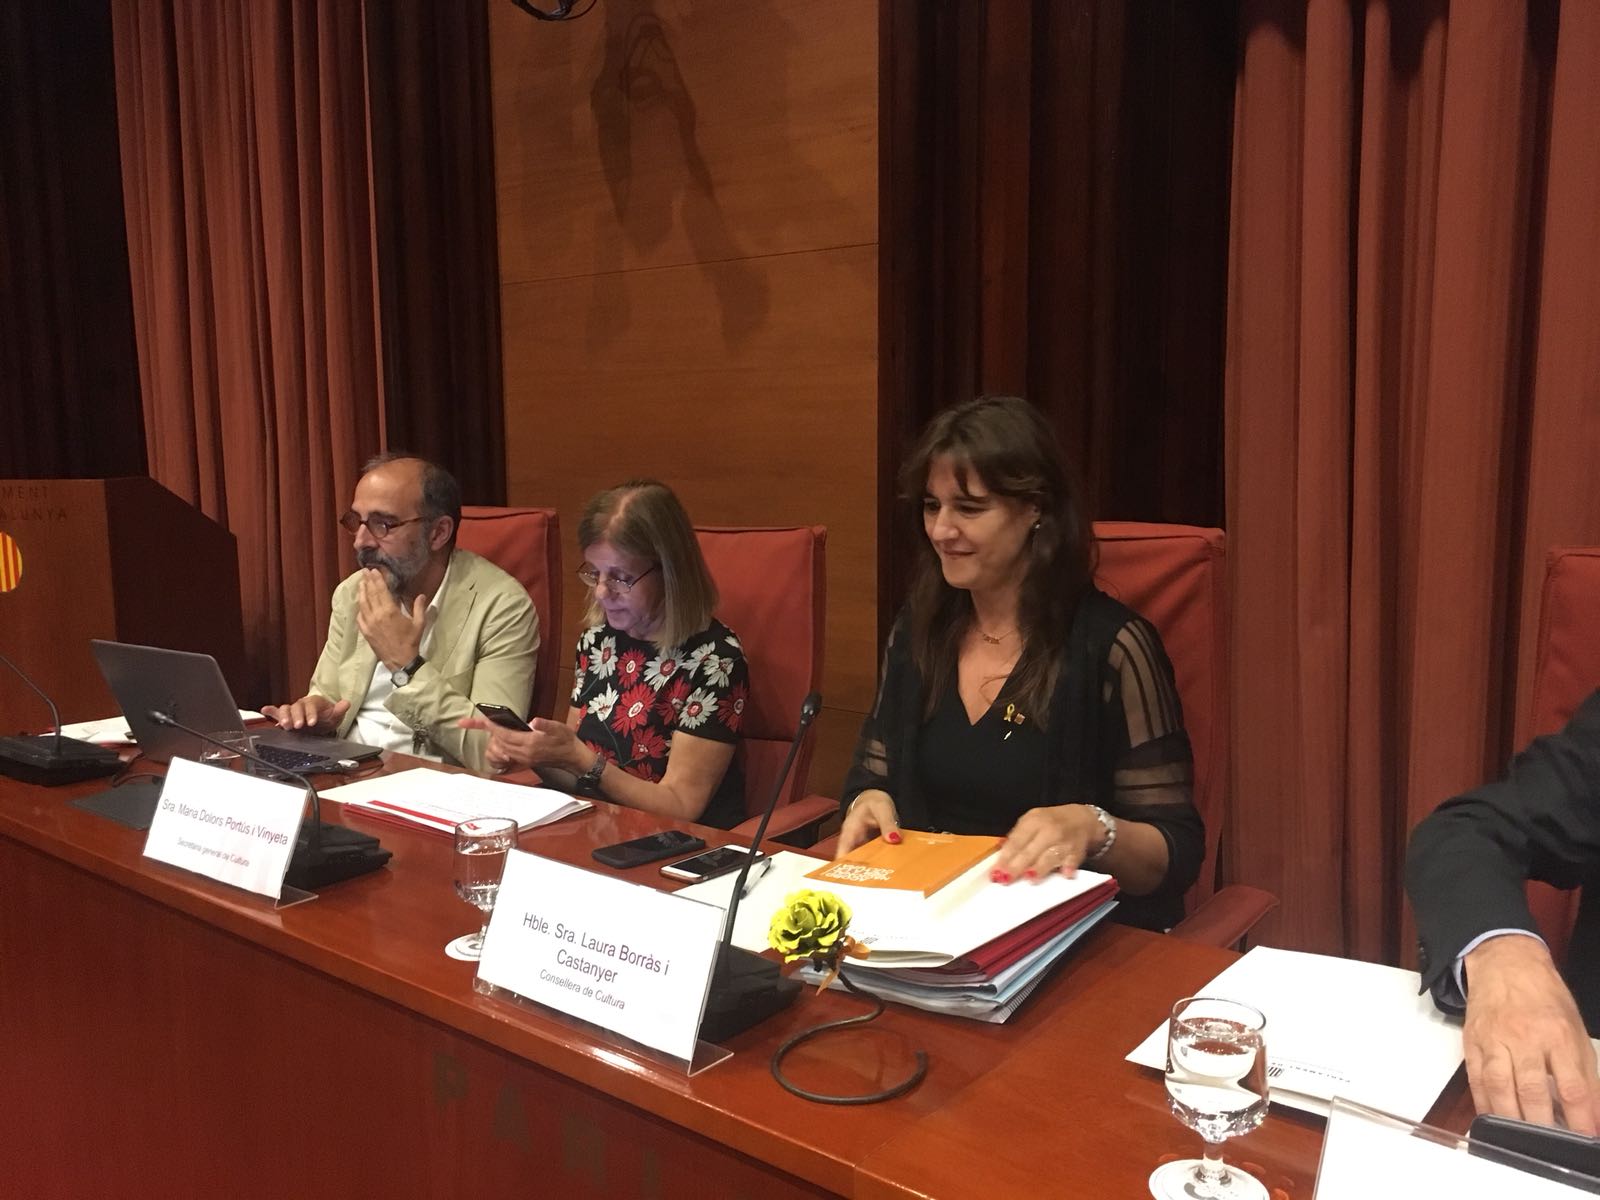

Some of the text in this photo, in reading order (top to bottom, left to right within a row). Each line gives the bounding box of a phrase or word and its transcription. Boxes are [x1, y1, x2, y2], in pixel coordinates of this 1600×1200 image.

[178, 803, 199, 819] Maria
[199, 810, 224, 827] Dolors
[257, 825, 289, 845] Vinyeta
[523, 912, 670, 976] Hble. Sra. Laura Borràs i
[556, 949, 618, 983] Castanyer
[539, 969, 625, 1010] Consellera de Cultura
